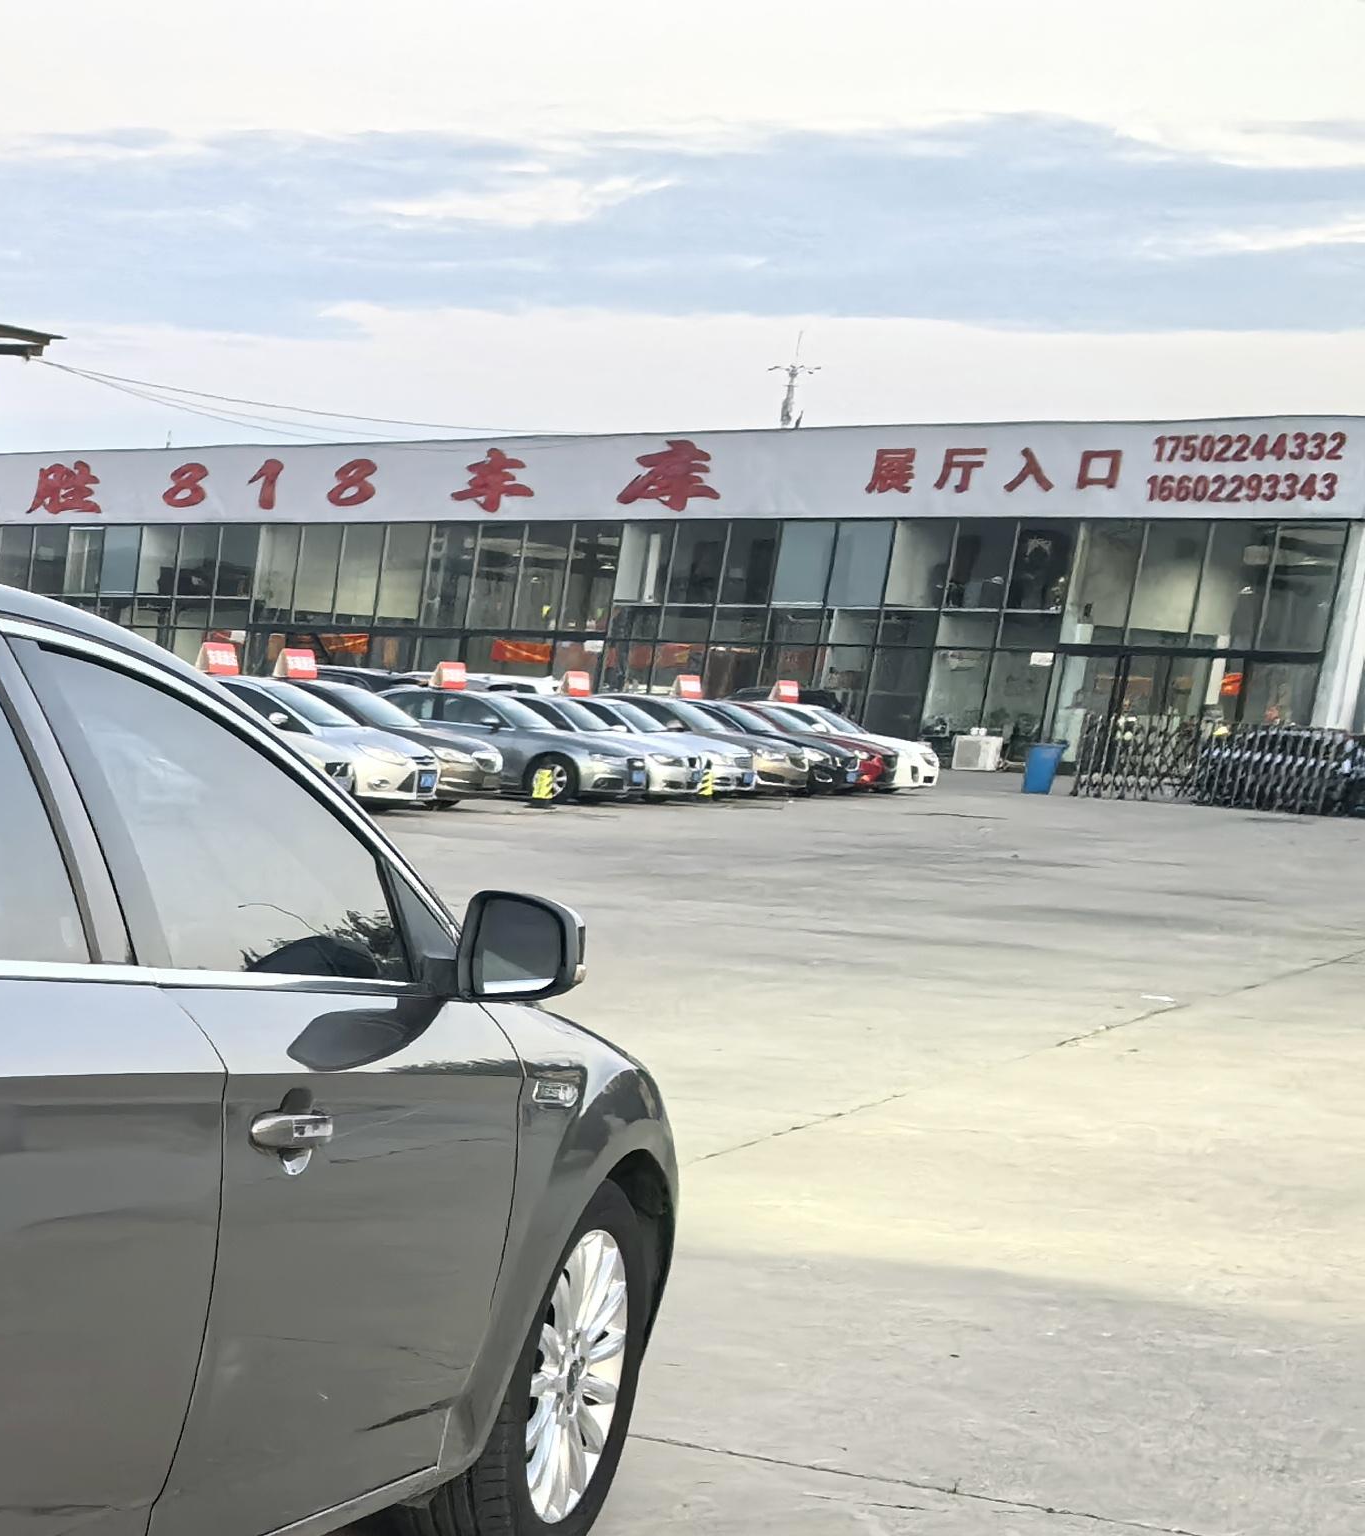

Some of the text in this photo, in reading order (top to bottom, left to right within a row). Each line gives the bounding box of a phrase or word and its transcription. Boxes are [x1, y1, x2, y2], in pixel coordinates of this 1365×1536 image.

[1153, 431, 1347, 463] 17502244332
[865, 446, 1123, 494] 展厅入口
[1146, 472, 1339, 503] 16602293343
